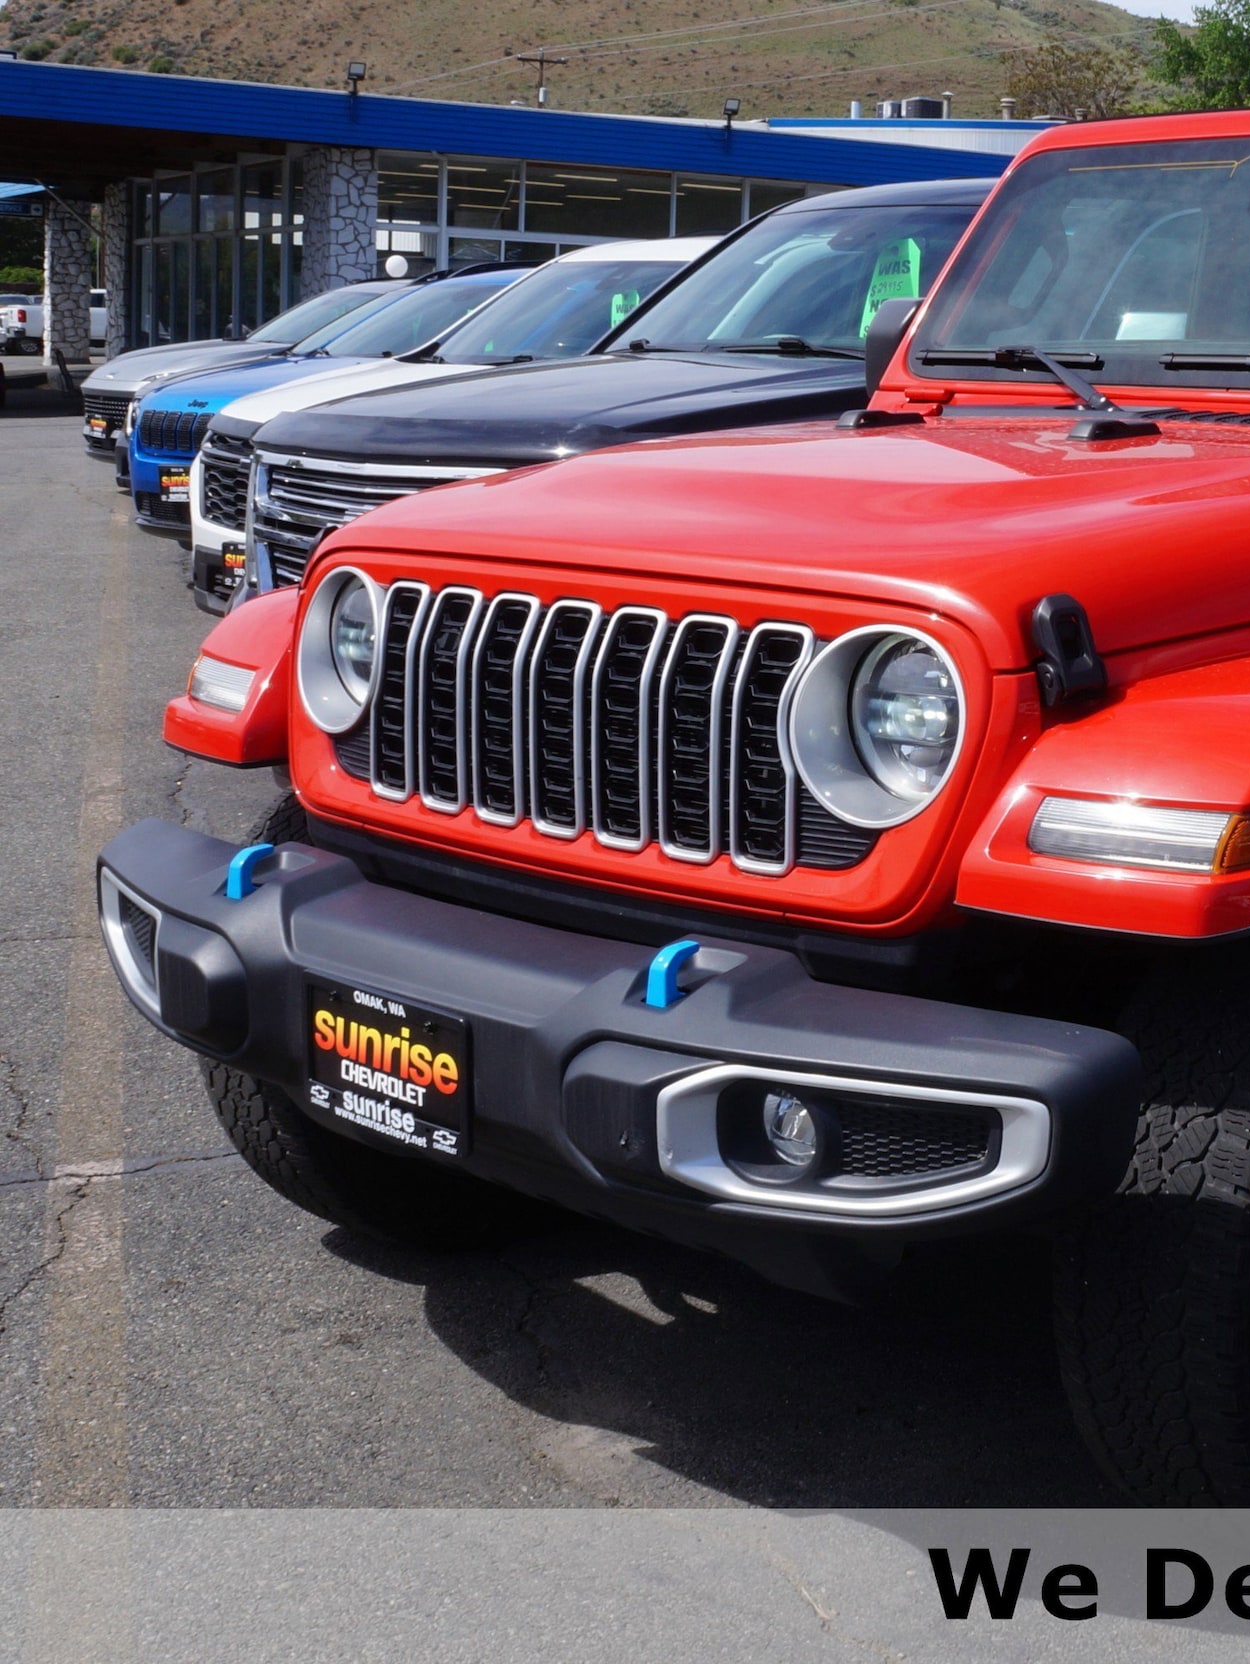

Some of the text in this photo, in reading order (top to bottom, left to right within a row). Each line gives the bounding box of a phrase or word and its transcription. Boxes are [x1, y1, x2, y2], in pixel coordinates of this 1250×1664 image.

[879, 260, 911, 276] WAS
[187, 400, 209, 409] Jeep
[161, 473, 190, 487] sunris
[353, 990, 406, 1018] OMAK, WA
[314, 1009, 459, 1095] sunrise
[340, 1059, 427, 1107] CHEVROLET
[334, 1106, 428, 1148] www.sunrisechevy.net
[342, 1091, 415, 1133] sunrise
